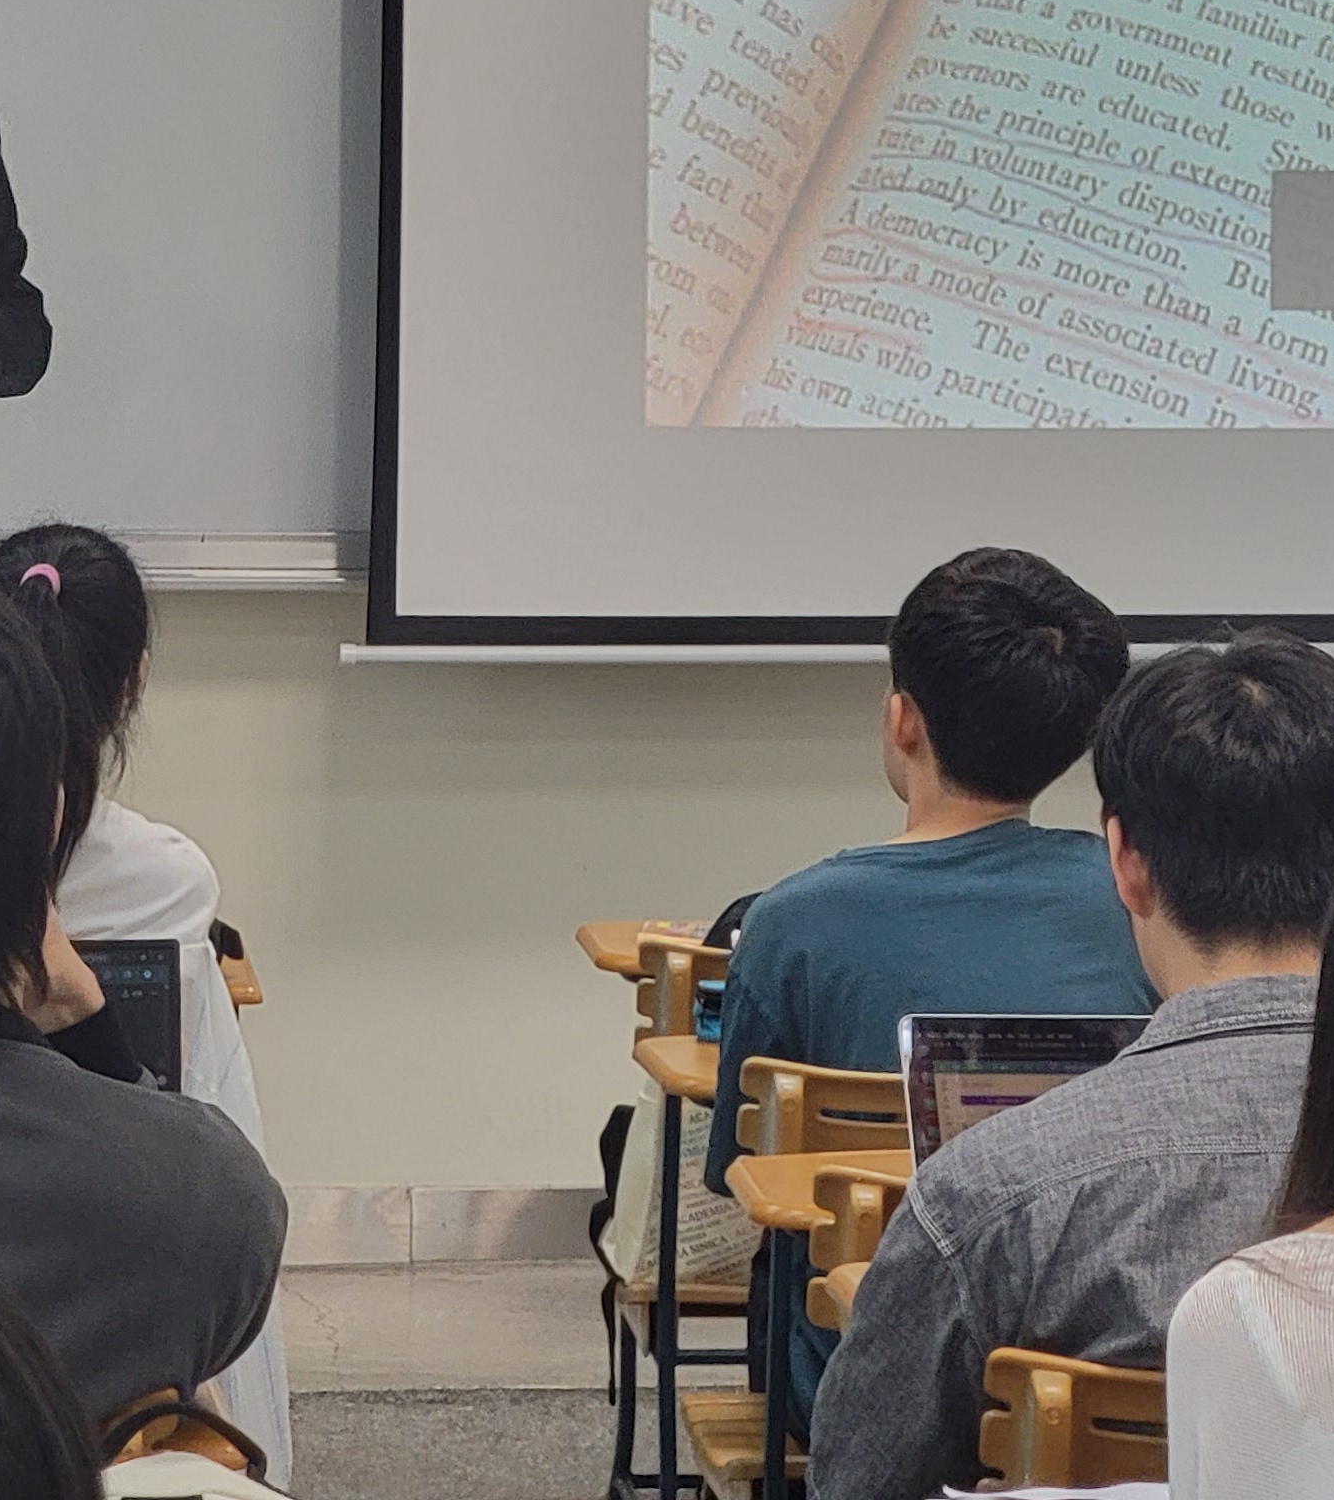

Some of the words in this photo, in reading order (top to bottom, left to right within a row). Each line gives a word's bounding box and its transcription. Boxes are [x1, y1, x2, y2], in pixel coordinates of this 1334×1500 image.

[969, 25, 1102, 71] successful
[1115, 55, 1203, 99] unless
[1220, 84, 1298, 131] those
[1039, 0, 1058, 21] a
[1065, 7, 1236, 72] government
[948, 93, 993, 125] the
[995, 109, 1124, 160] principle
[1131, 144, 1167, 176] of
[1040, 77, 1089, 107] are
[1097, 94, 1235, 153] educated.
[917, 174, 980, 212] only
[988, 185, 1027, 226] by
[1036, 202, 1188, 272] education.
[1225, 257, 1270, 300] Bu
[931, 127, 959, 158] in
[970, 145, 1108, 202] voluntary
[1117, 180, 1272, 251] disposition
[839, 197, 861, 226] A
[867, 202, 1010, 265] democracy
[1017, 238, 1046, 271] is
[1053, 256, 1131, 299] more
[1144, 281, 1213, 327] than
[1223, 314, 1243, 337] a
[1255, 317, 1330, 368] form
[799, 377, 854, 410] own
[802, 284, 935, 336] experience.
[971, 319, 1032, 364] The
[1044, 352, 1191, 419] extension
[875, 346, 933, 381] who
[901, 263, 921, 283] a
[929, 268, 1009, 307] mode
[1017, 291, 1054, 321] of
[1058, 307, 1220, 377] associated
[1227, 353, 1323, 424] living,
